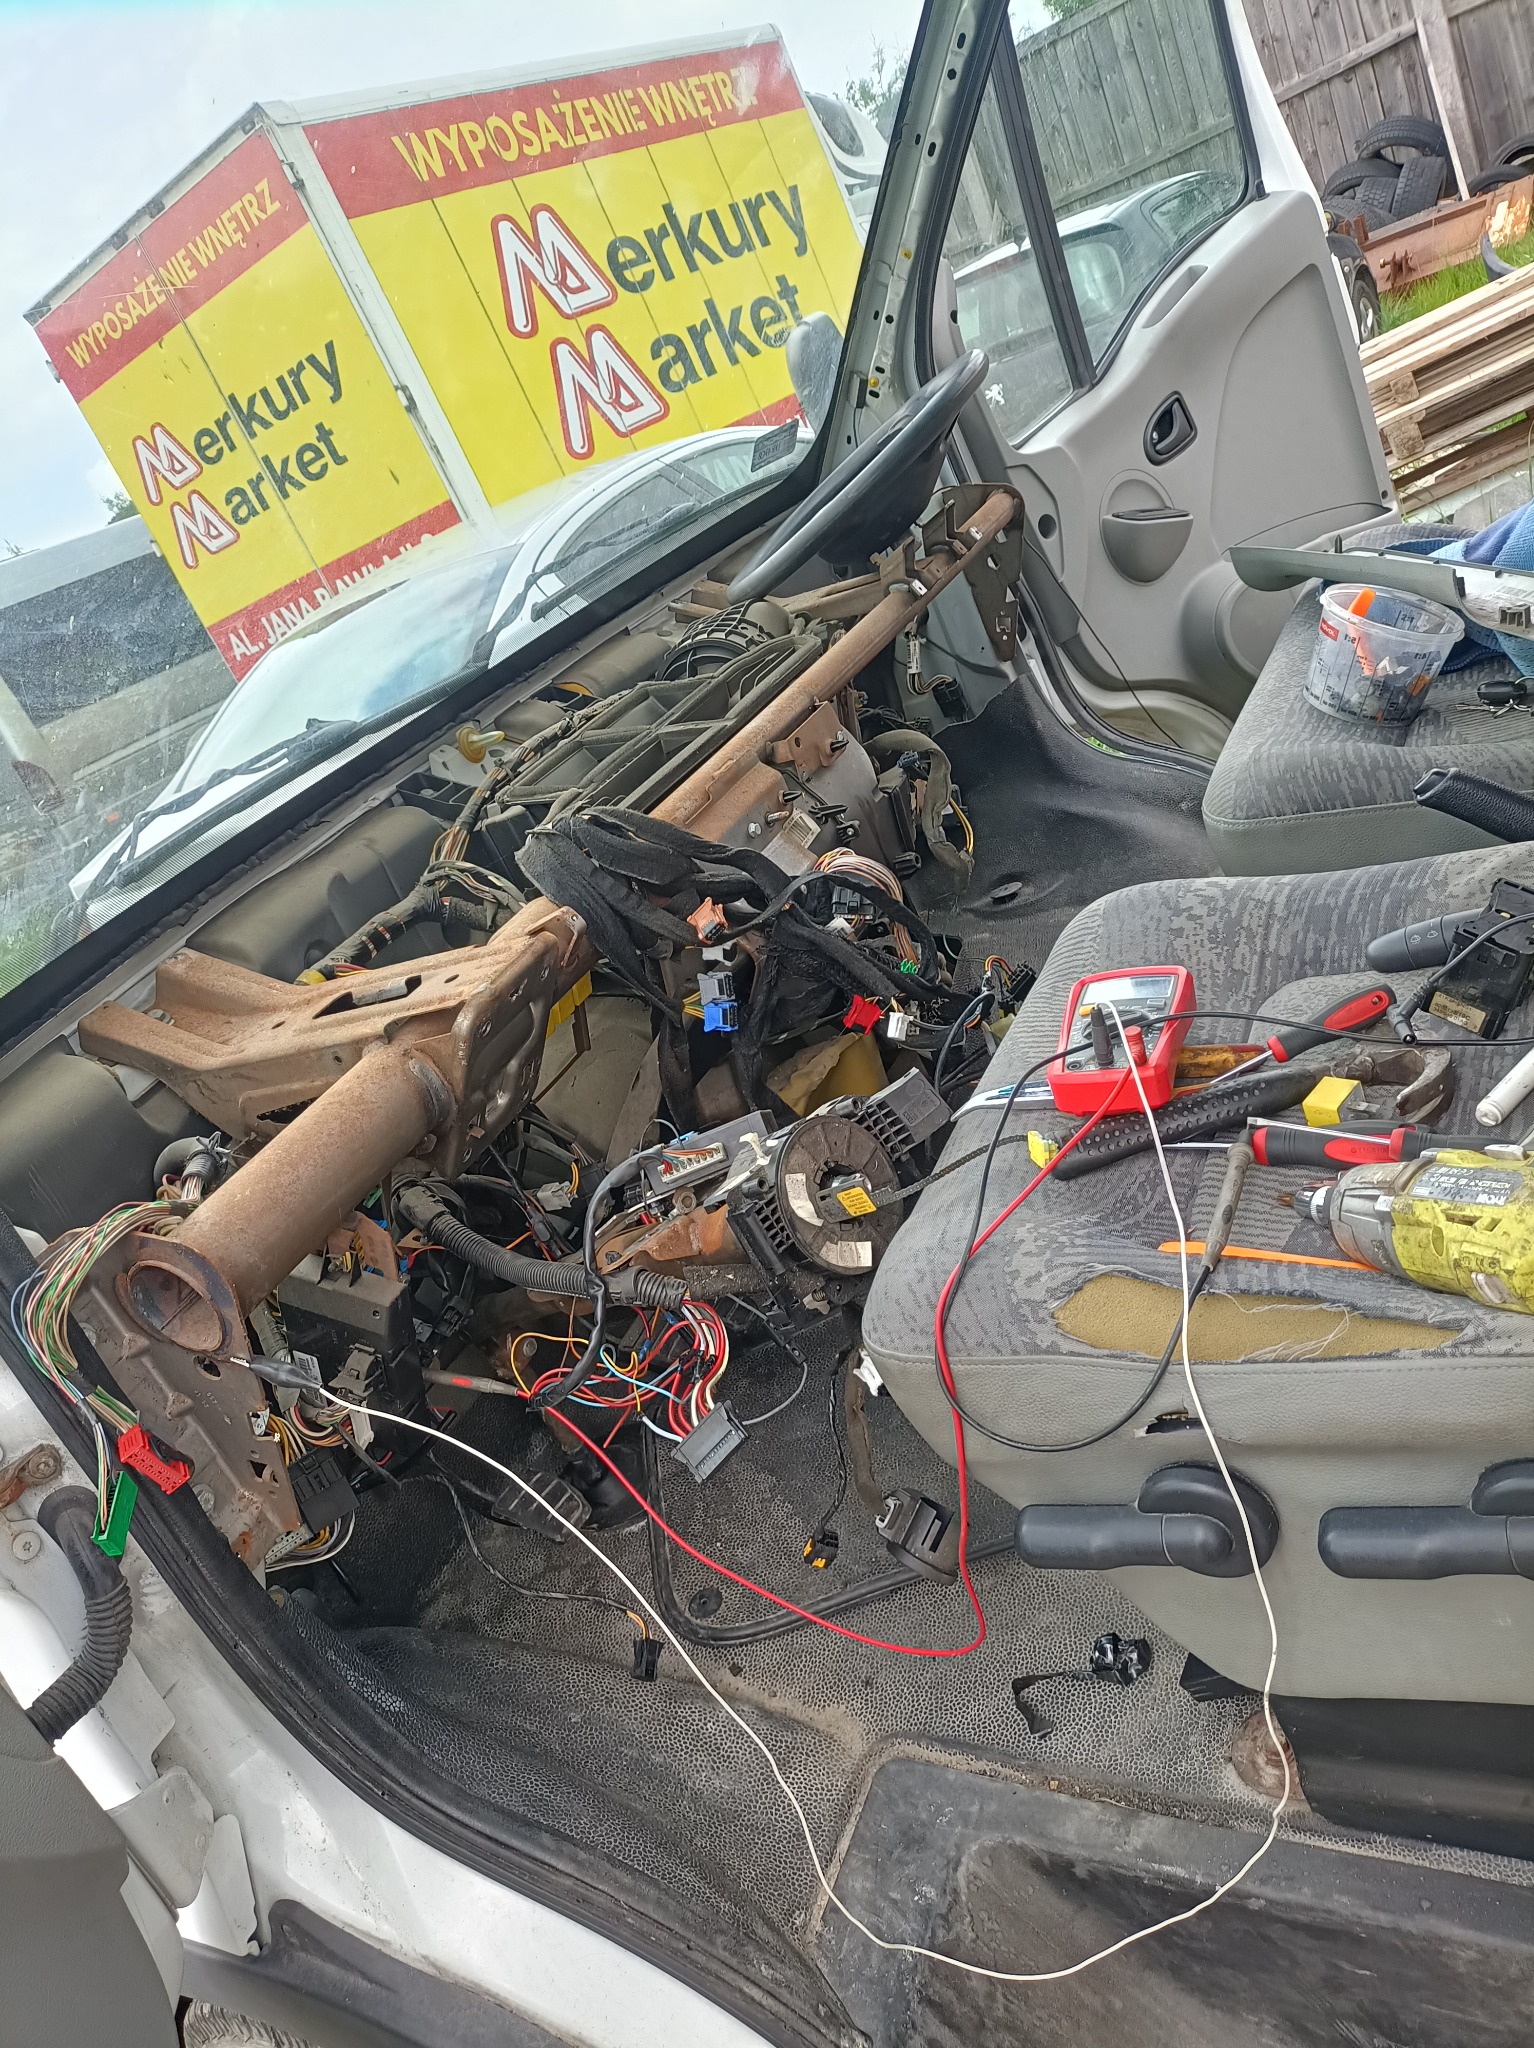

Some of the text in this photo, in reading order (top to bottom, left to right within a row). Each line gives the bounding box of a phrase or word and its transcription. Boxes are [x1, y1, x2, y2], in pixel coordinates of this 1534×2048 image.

[391, 88, 648, 182] WYPOSAŻENIE
[65, 177, 281, 369] WYPOSAŻENIE WNĘTRZ
[491, 184, 809, 339] Merkury
[132, 339, 343, 506] Merkury
[549, 274, 803, 460] Market
[170, 421, 349, 570] Market
[228, 626, 266, 661] AL.
